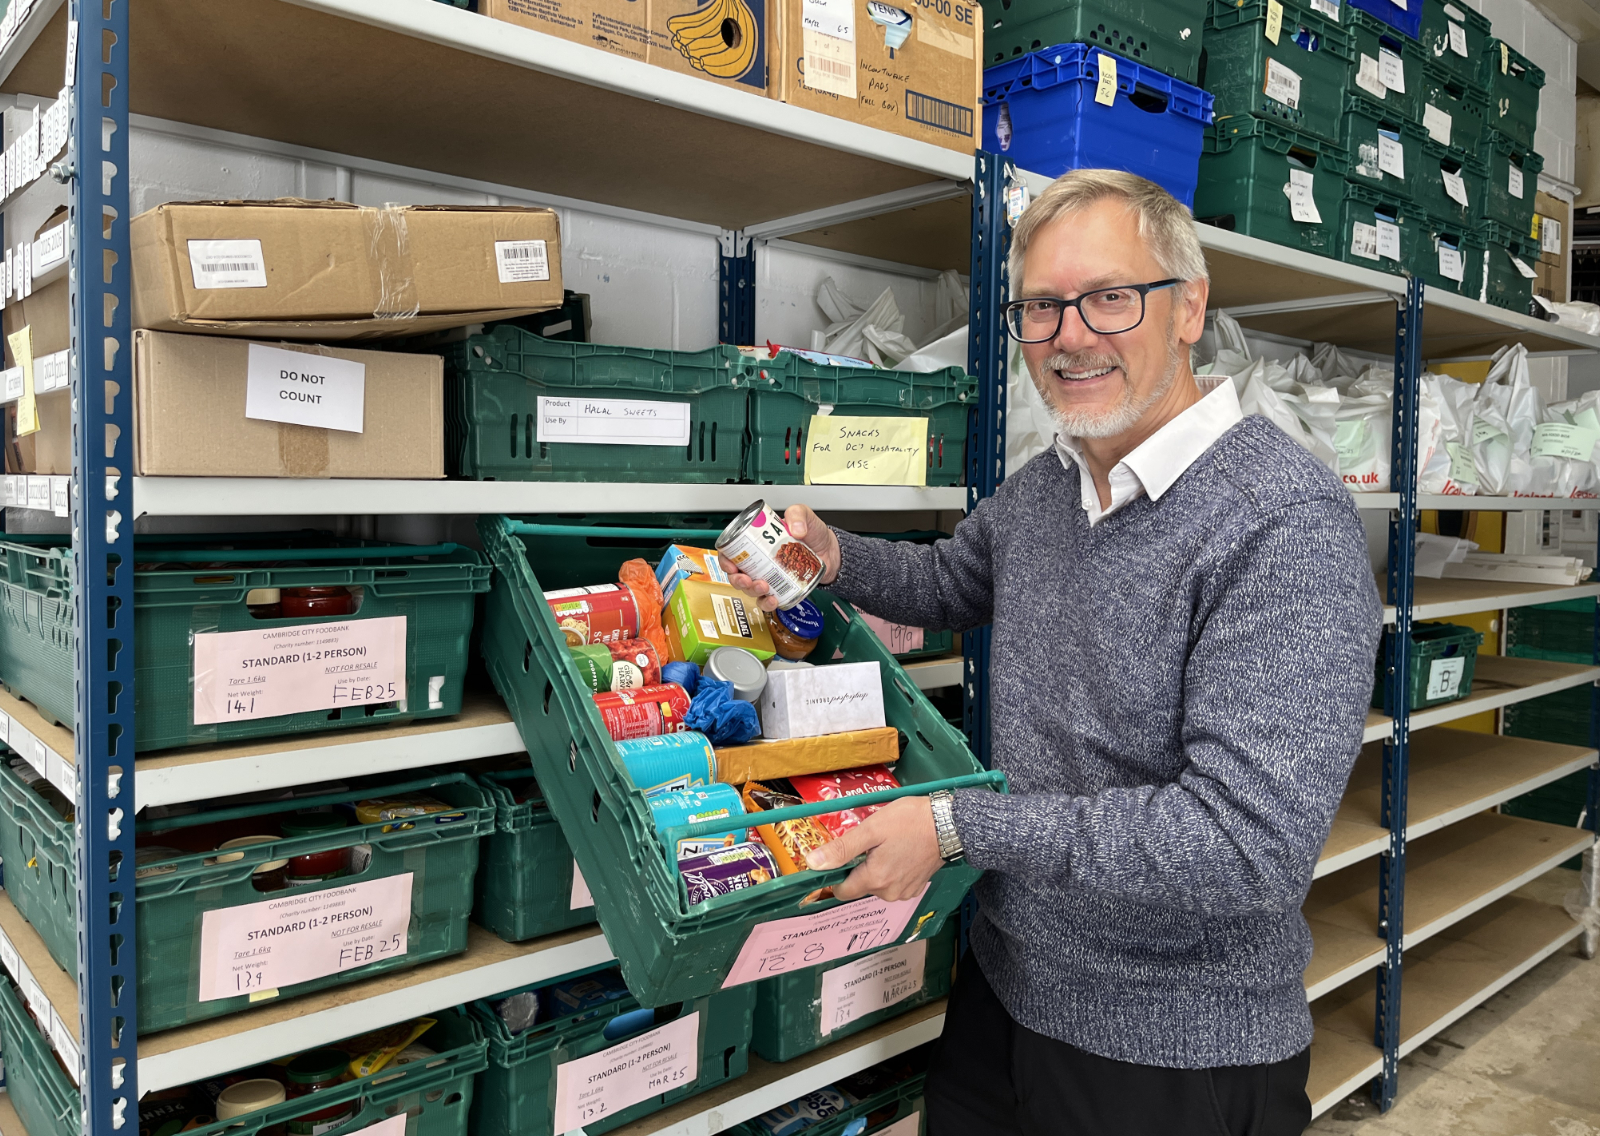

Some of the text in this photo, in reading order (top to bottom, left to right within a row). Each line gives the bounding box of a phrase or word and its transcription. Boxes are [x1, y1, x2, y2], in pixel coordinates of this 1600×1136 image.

[872, 1, 899, 18] TENA
[955, 10, 973, 26] SE
[868, 78, 890, 92] PADS
[280, 370, 326, 385] DO NOT
[279, 390, 322, 404] COUNT
[545, 400, 658, 417] Product HALAL SWEETS
[838, 426, 880, 439] SNACKS
[812, 442, 831, 452] FOR
[1342, 472, 1379, 484] co.uk
[734, 598, 744, 620] GOLD
[263, 625, 350, 639] CAMBRIDGE CITY FOODBANK
[738, 618, 752, 636] LABEL
[242, 646, 367, 668] STANDARD (1-2 PERSON)
[325, 661, 378, 674] NOT FOR RESALE
[588, 660, 598, 686] CHOPPED
[229, 675, 266, 685] Tare 1.6kg
[618, 667, 626, 690] HARV
[624, 664, 632, 689] GROW
[240, 689, 263, 698] Weight:
[805, 697, 830, 706] ORGANIC
[268, 887, 357, 910] CAMBRIDGE CITY FOODBANK
[247, 905, 373, 941] STANDARD (1-2 PERSON)
[331, 919, 383, 938] NOT FOR RESALE
[781, 907, 887, 941] STANDARD (1-2 PERSON)
[361, 935, 375, 943] Date:
[233, 946, 271, 959] Tare 1.6kg
[339, 933, 400, 968] FEB 25
[244, 960, 268, 970] Weight:
[844, 959, 907, 989] STANDARD (1-2 PERSON)
[602, 1030, 661, 1058] CAMBRIDGE CITY FOODBANK
[588, 1042, 671, 1084] STANDARD (1-2 PERSON)
[649, 1065, 688, 1089] MAR 25
[582, 1102, 608, 1120] 13.2
